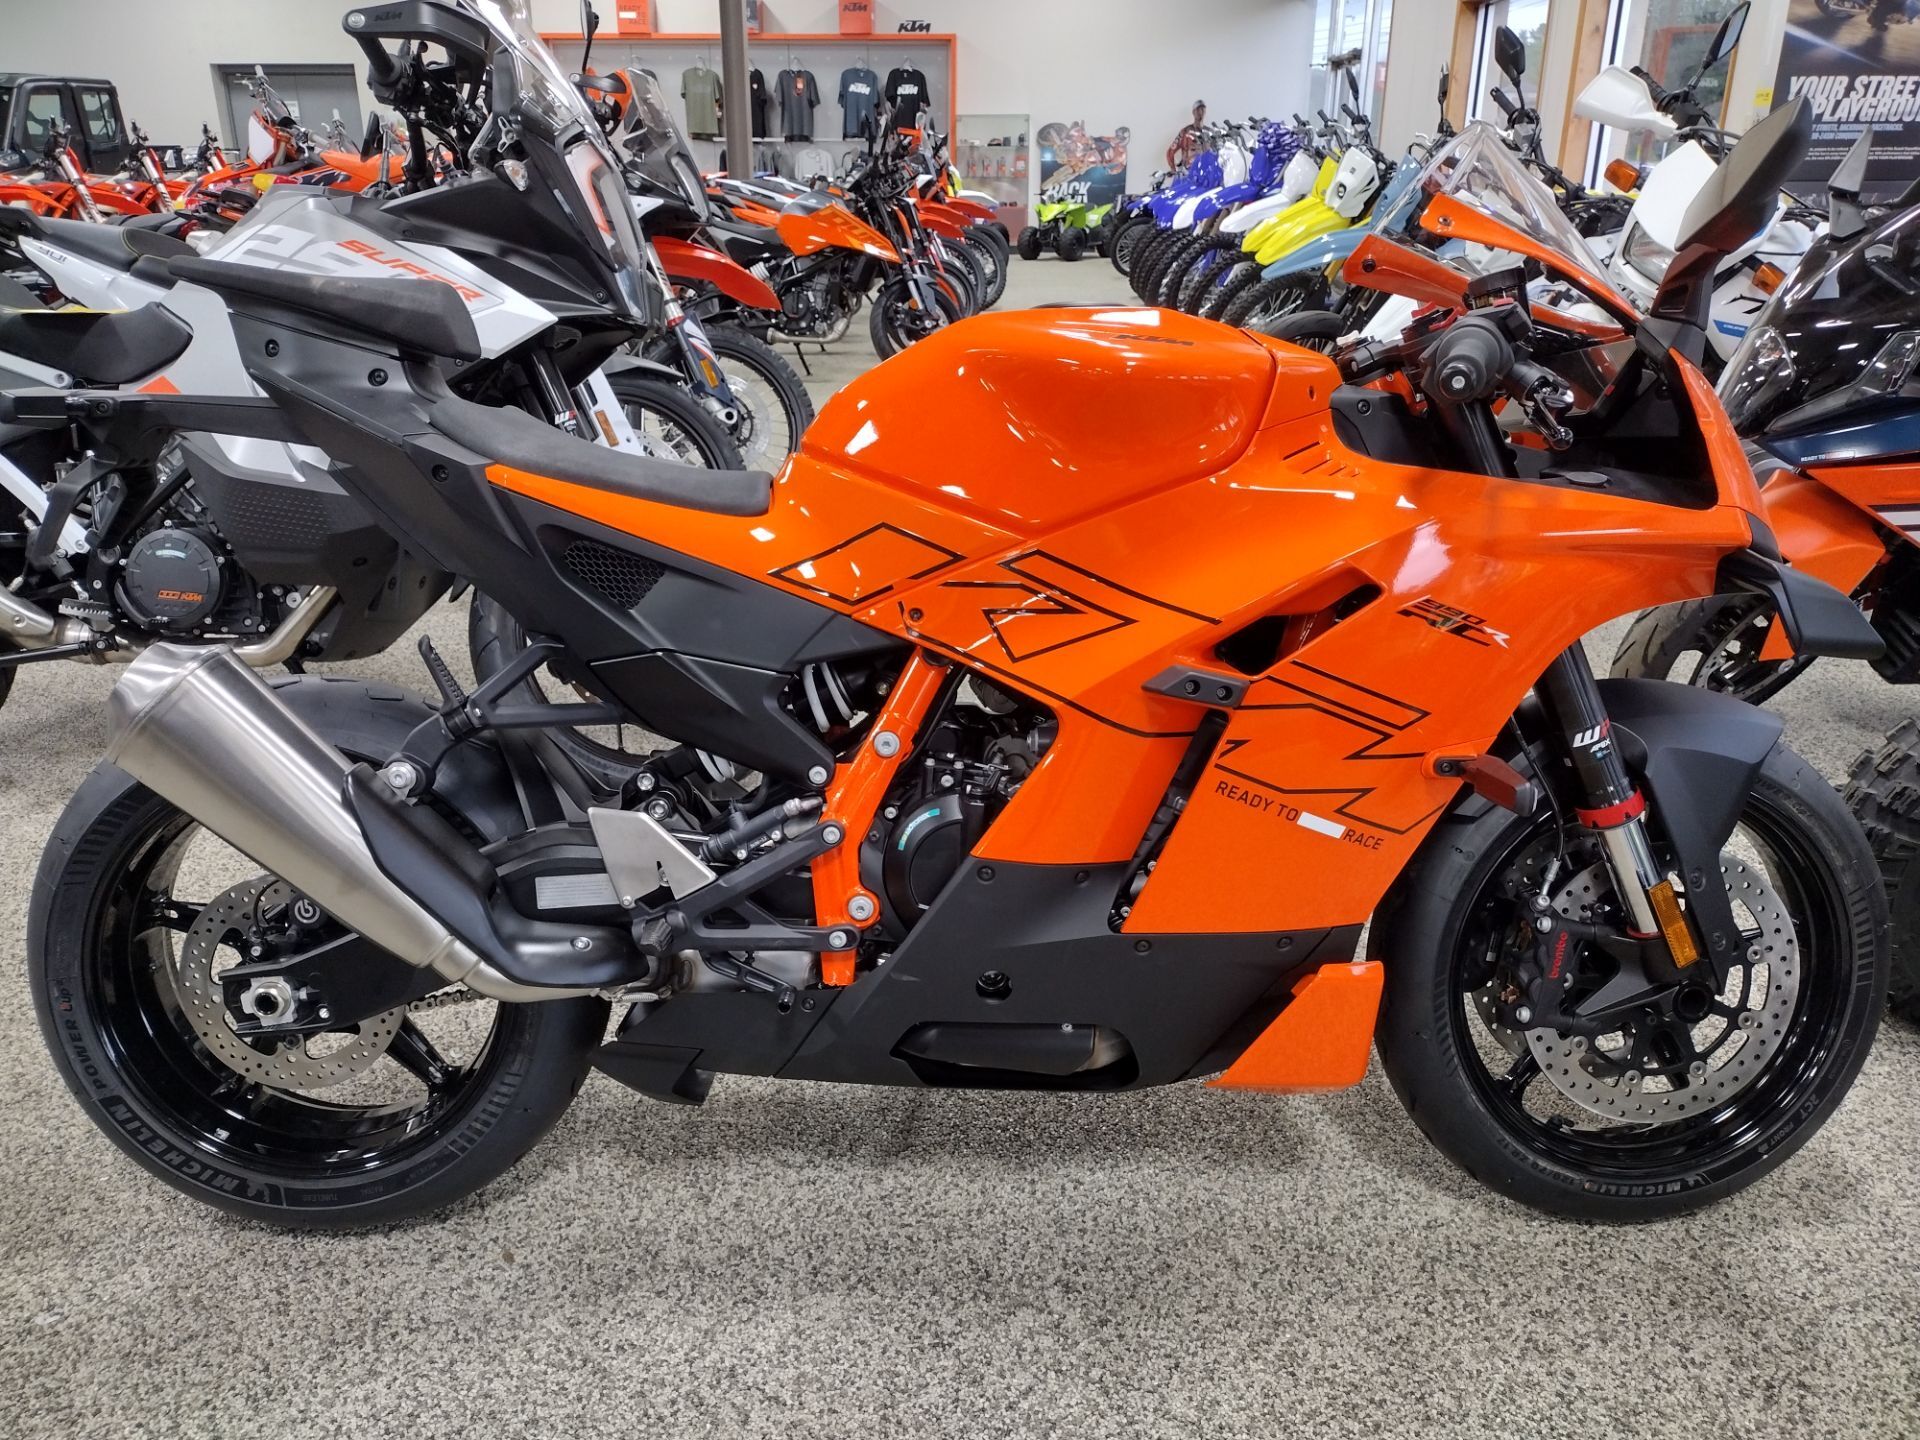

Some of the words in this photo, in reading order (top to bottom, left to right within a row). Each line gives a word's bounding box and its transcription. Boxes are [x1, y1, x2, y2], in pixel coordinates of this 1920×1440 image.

[843, 2, 868, 12] KTM
[898, 20, 931, 33] KTM
[848, 82, 871, 95] KTM
[896, 84, 918, 95] KTM
[1787, 75, 1849, 101] YOUR
[336, 239, 484, 302] SUPER
[1215, 780, 1274, 812] READY
[1276, 803, 1299, 822] TO
[1343, 828, 1385, 850] RACE
[1549, 930, 1569, 979] brembo
[64, 1018, 108, 1094] POWER
[108, 1103, 240, 1191] MICHELIN
[1583, 1180, 1681, 1198] MICHELIN
